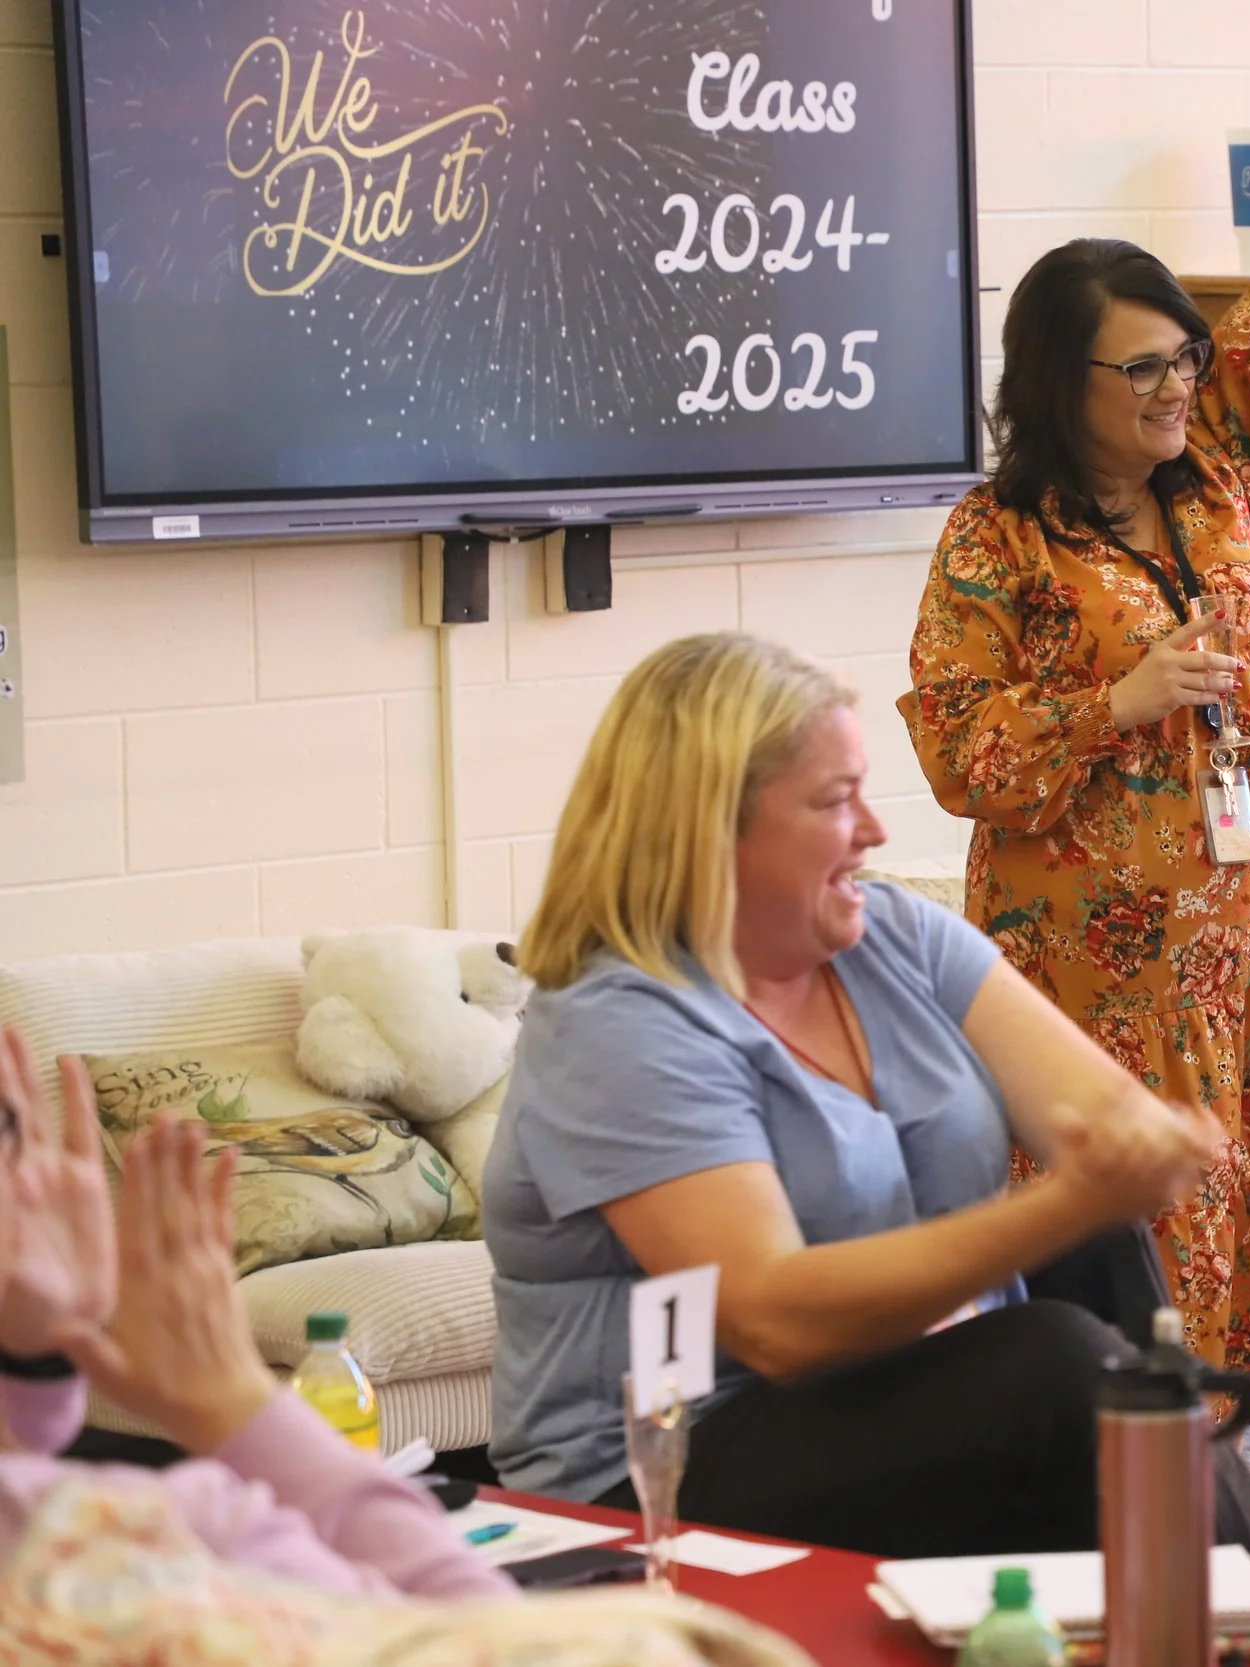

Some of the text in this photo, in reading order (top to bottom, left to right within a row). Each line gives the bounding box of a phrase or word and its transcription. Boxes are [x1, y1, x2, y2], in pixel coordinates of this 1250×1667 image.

[224, 10, 508, 178] We
[687, 51, 857, 133] Class
[244, 131, 490, 296] Did it
[654, 193, 890, 274] 2024-
[677, 330, 879, 415] 2025
[95, 1061, 213, 1109] Sing
[662, 1295, 680, 1364] 1
